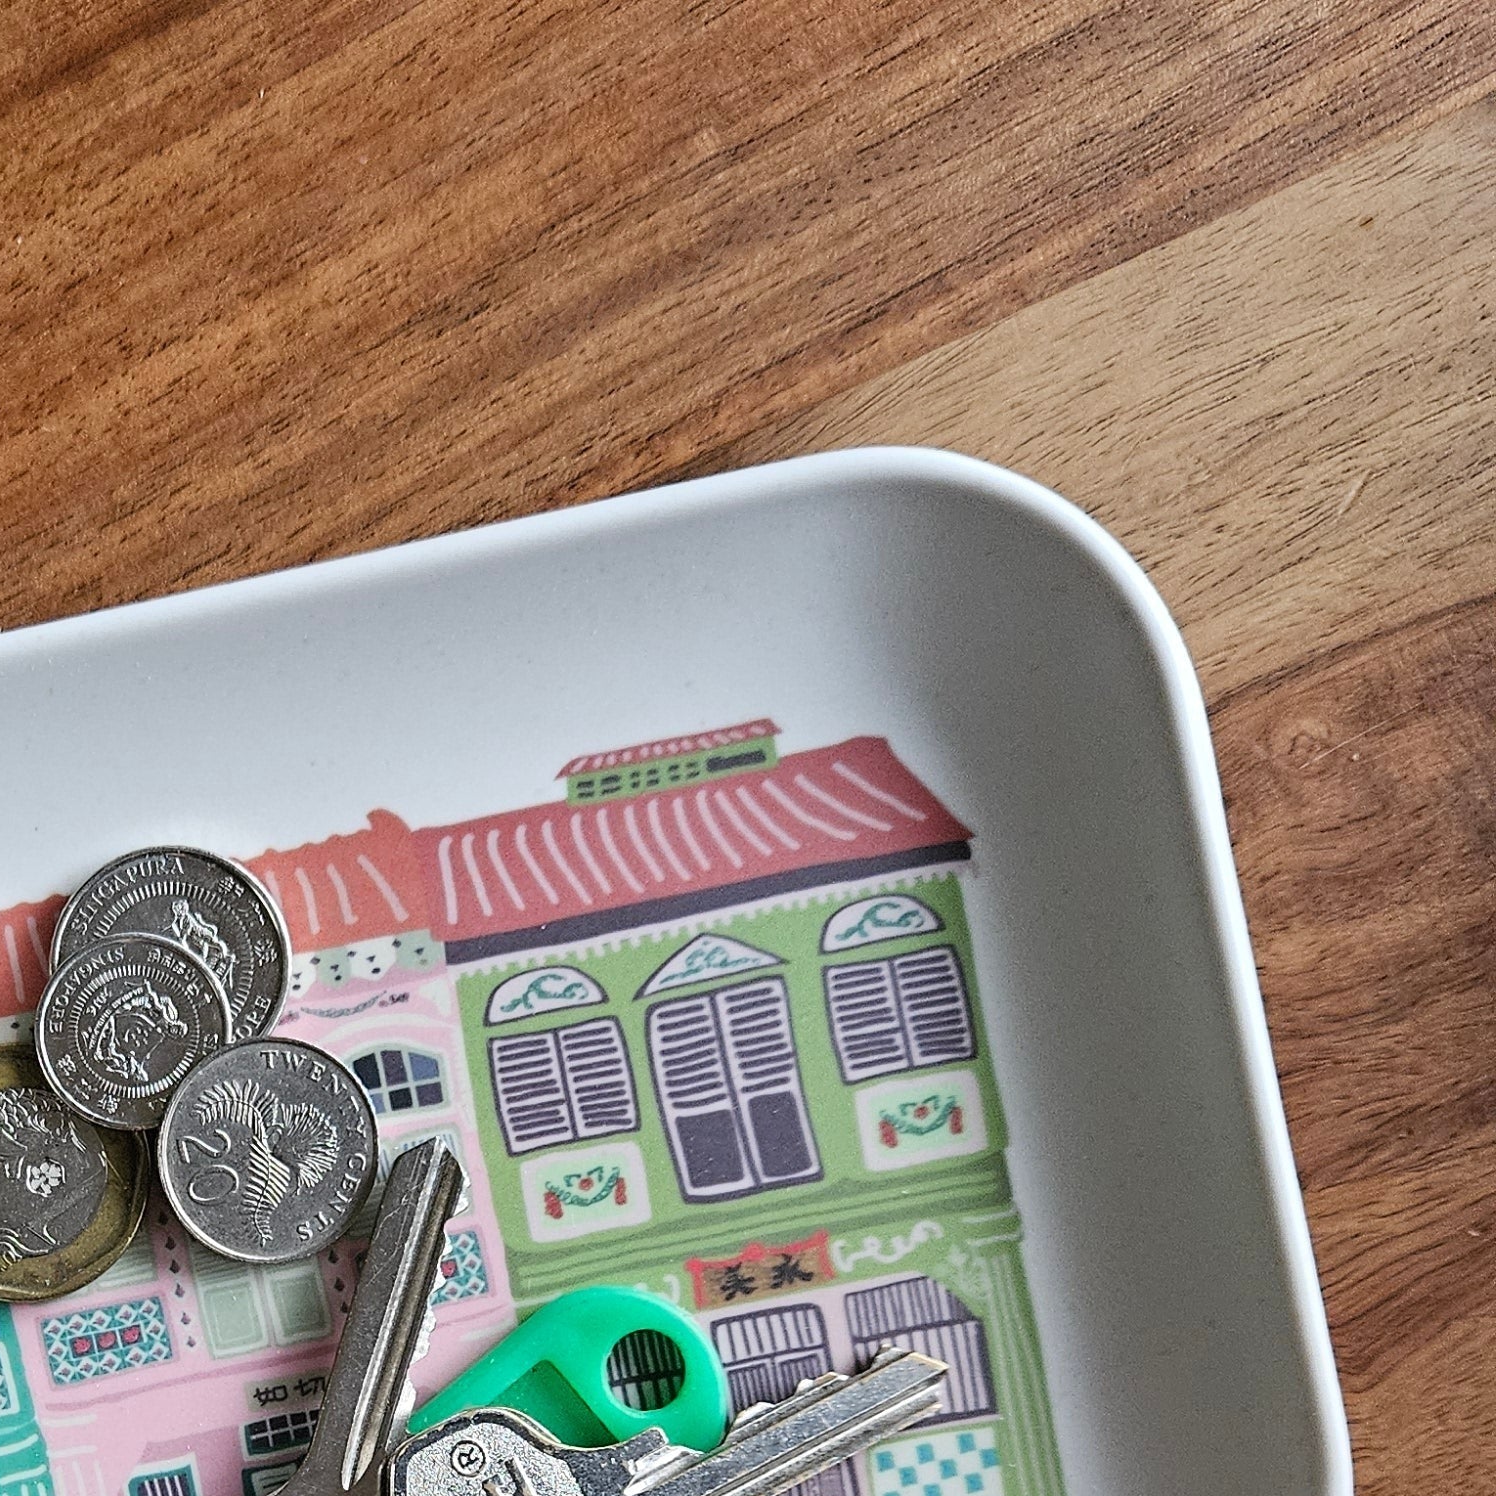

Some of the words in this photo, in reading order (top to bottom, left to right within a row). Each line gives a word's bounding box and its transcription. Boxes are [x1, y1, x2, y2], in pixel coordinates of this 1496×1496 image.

[259, 1047, 368, 1140] TWENTY
[175, 1126, 242, 1206] 20
[297, 1152, 368, 1243] CENTS
